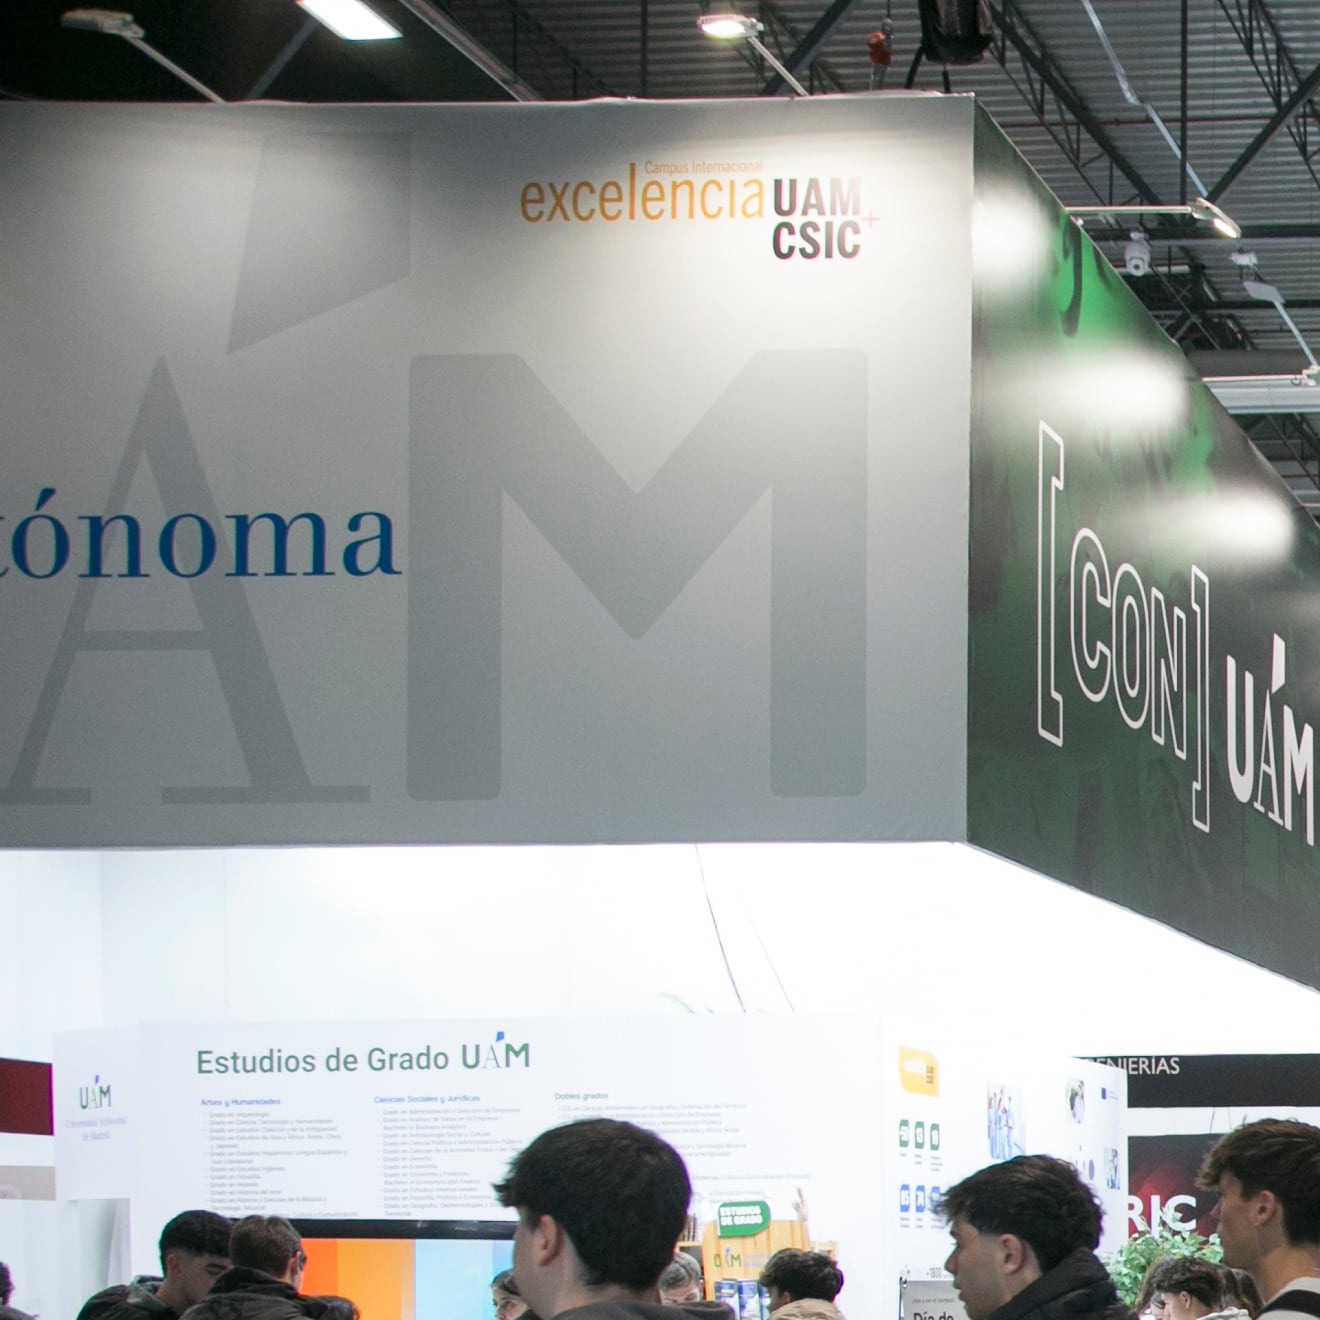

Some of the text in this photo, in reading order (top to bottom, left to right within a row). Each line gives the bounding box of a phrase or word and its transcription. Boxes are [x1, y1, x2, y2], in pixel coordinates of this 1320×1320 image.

[645, 160, 764, 176] Campus Internacional
[520, 162, 861, 222] excelencia UAM
[773, 220, 862, 259] CSIC
[1226, 633, 1314, 847] UÁM
[197, 1048, 316, 1075] Estudios
[324, 1047, 359, 1073] de
[367, 1044, 450, 1071] Grado
